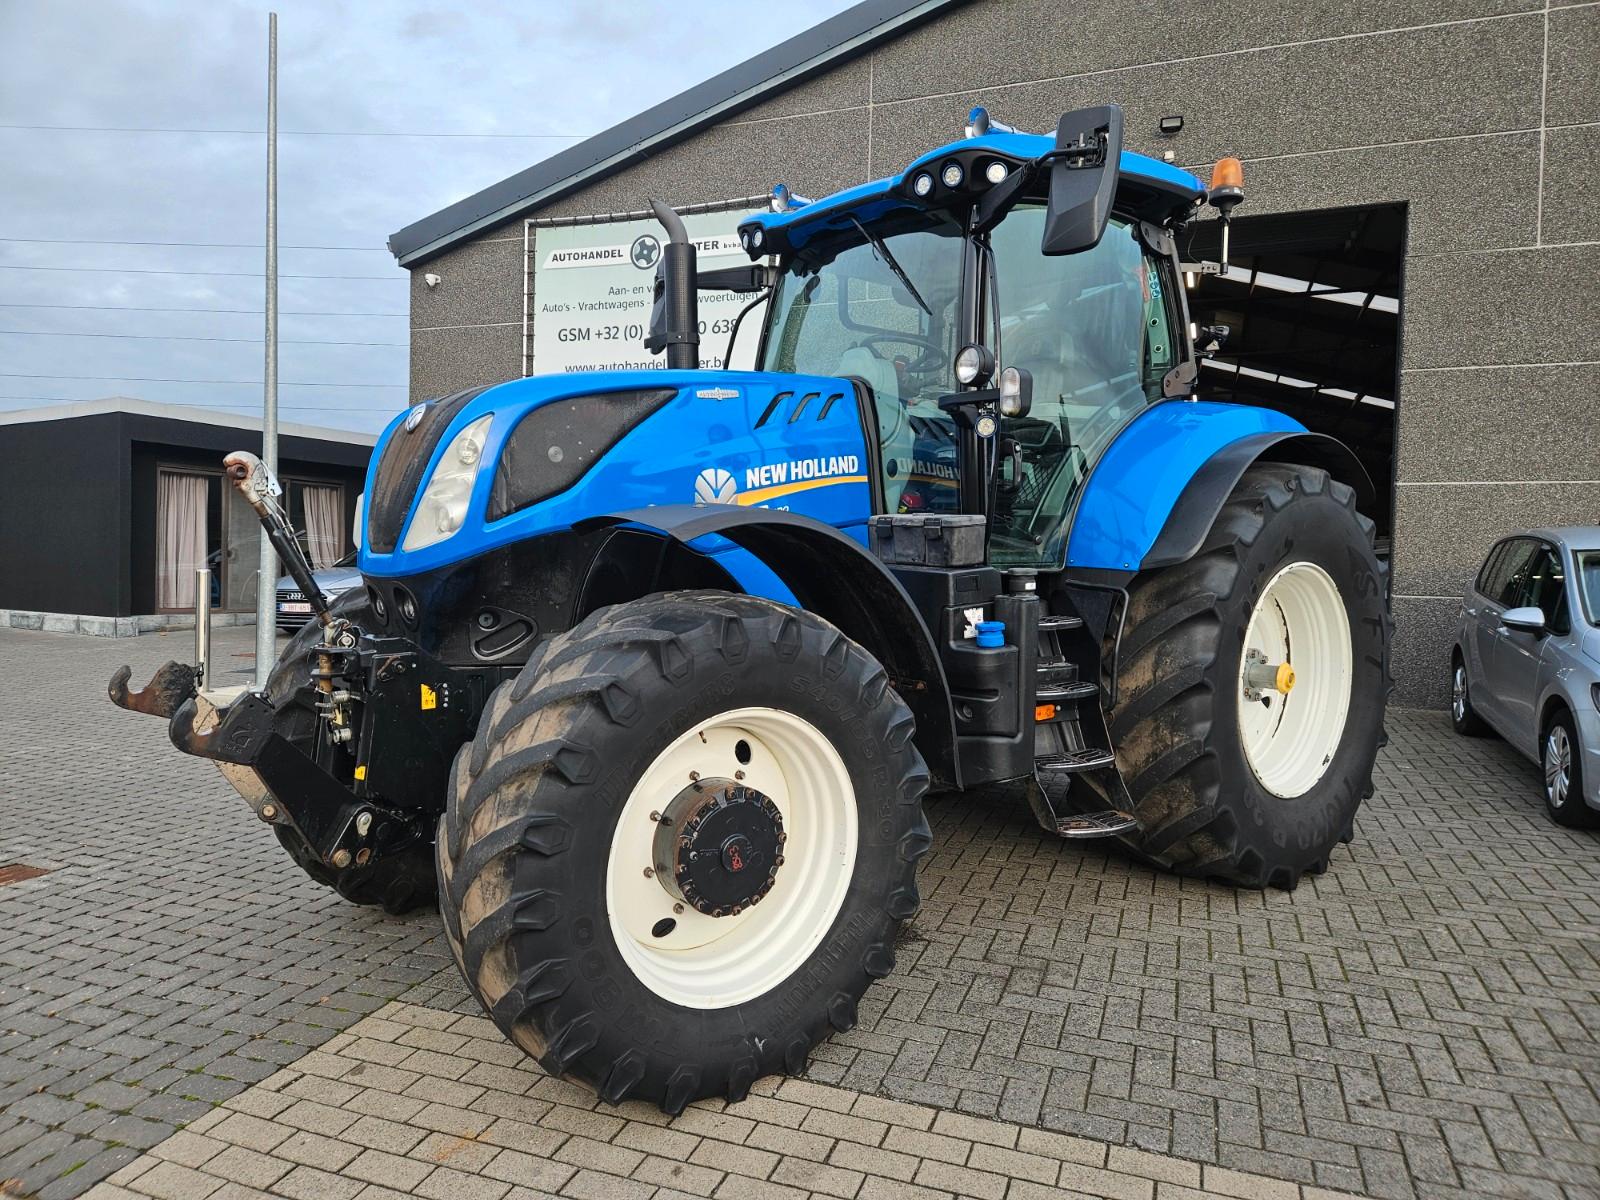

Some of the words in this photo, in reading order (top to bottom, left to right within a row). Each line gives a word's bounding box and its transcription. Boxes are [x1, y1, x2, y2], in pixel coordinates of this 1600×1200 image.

[551, 249, 624, 262] AUTOHANDEL
[608, 286, 630, 295] Aan-
[632, 286, 644, 294] en
[542, 303, 570, 312] Auto's
[578, 299, 645, 311] Vrachtwagens
[558, 327, 591, 342] GSM
[595, 325, 620, 340] +32
[624, 324, 643, 341] (0)
[746, 462, 788, 489] NEW
[790, 455, 858, 481] HOLLAND
